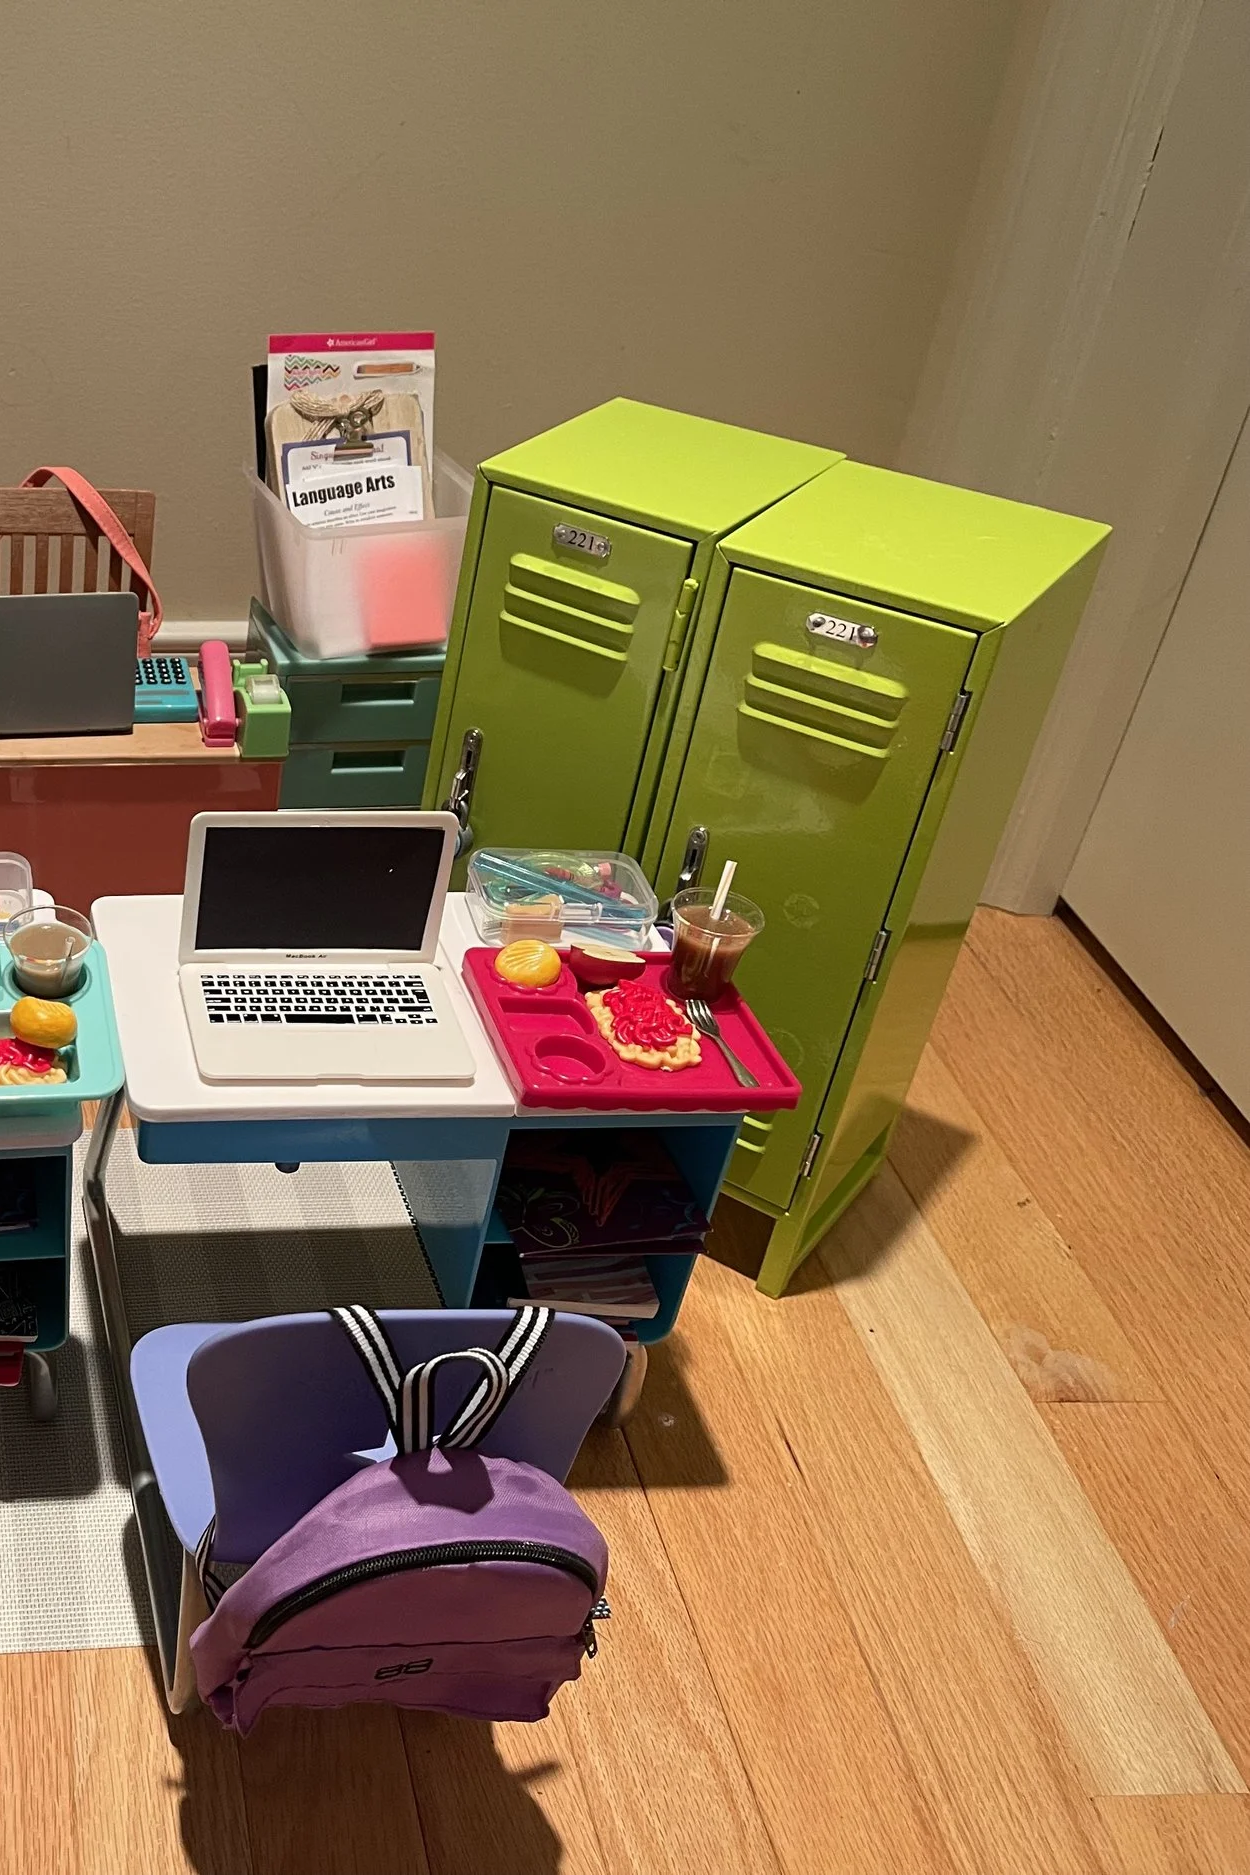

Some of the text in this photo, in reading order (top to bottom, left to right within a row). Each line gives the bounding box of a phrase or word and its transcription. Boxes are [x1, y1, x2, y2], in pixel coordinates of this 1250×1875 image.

[292, 475, 396, 508] Language Arts
[567, 530, 594, 550] 221
[825, 620, 855, 641] 221
